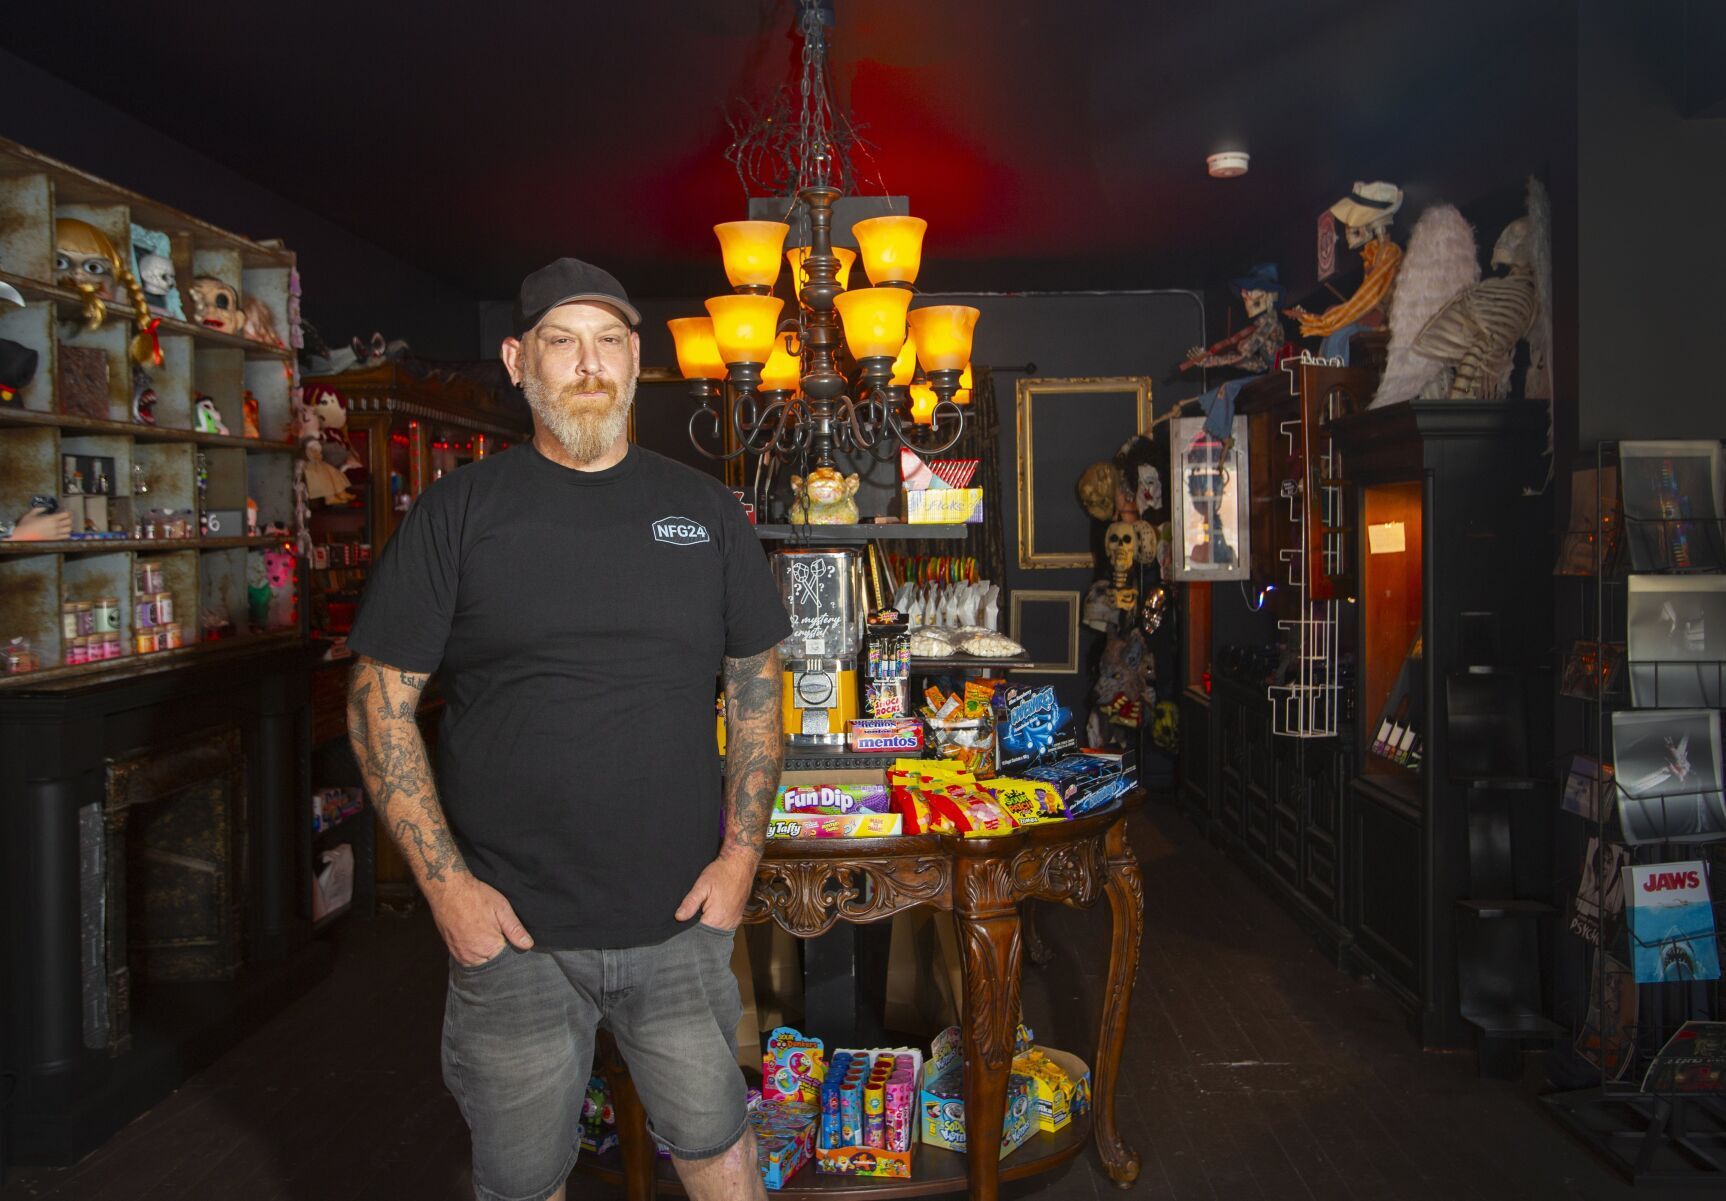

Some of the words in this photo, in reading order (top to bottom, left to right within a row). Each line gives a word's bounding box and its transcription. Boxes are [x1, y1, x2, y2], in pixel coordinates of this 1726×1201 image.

[208, 513, 221, 532] 6
[656, 524, 706, 538] NFG24
[800, 612, 842, 629] mystery
[793, 625, 830, 642] crystal
[858, 735, 918, 749] mentos
[784, 790, 819, 811] Fun
[821, 787, 854, 813] Dip
[1005, 794, 1028, 805] SOUR
[1008, 800, 1034, 812] PATCH
[775, 821, 801, 836] Taffy
[1643, 870, 1700, 892] JAWS
[1568, 917, 1601, 946] PSYCH
